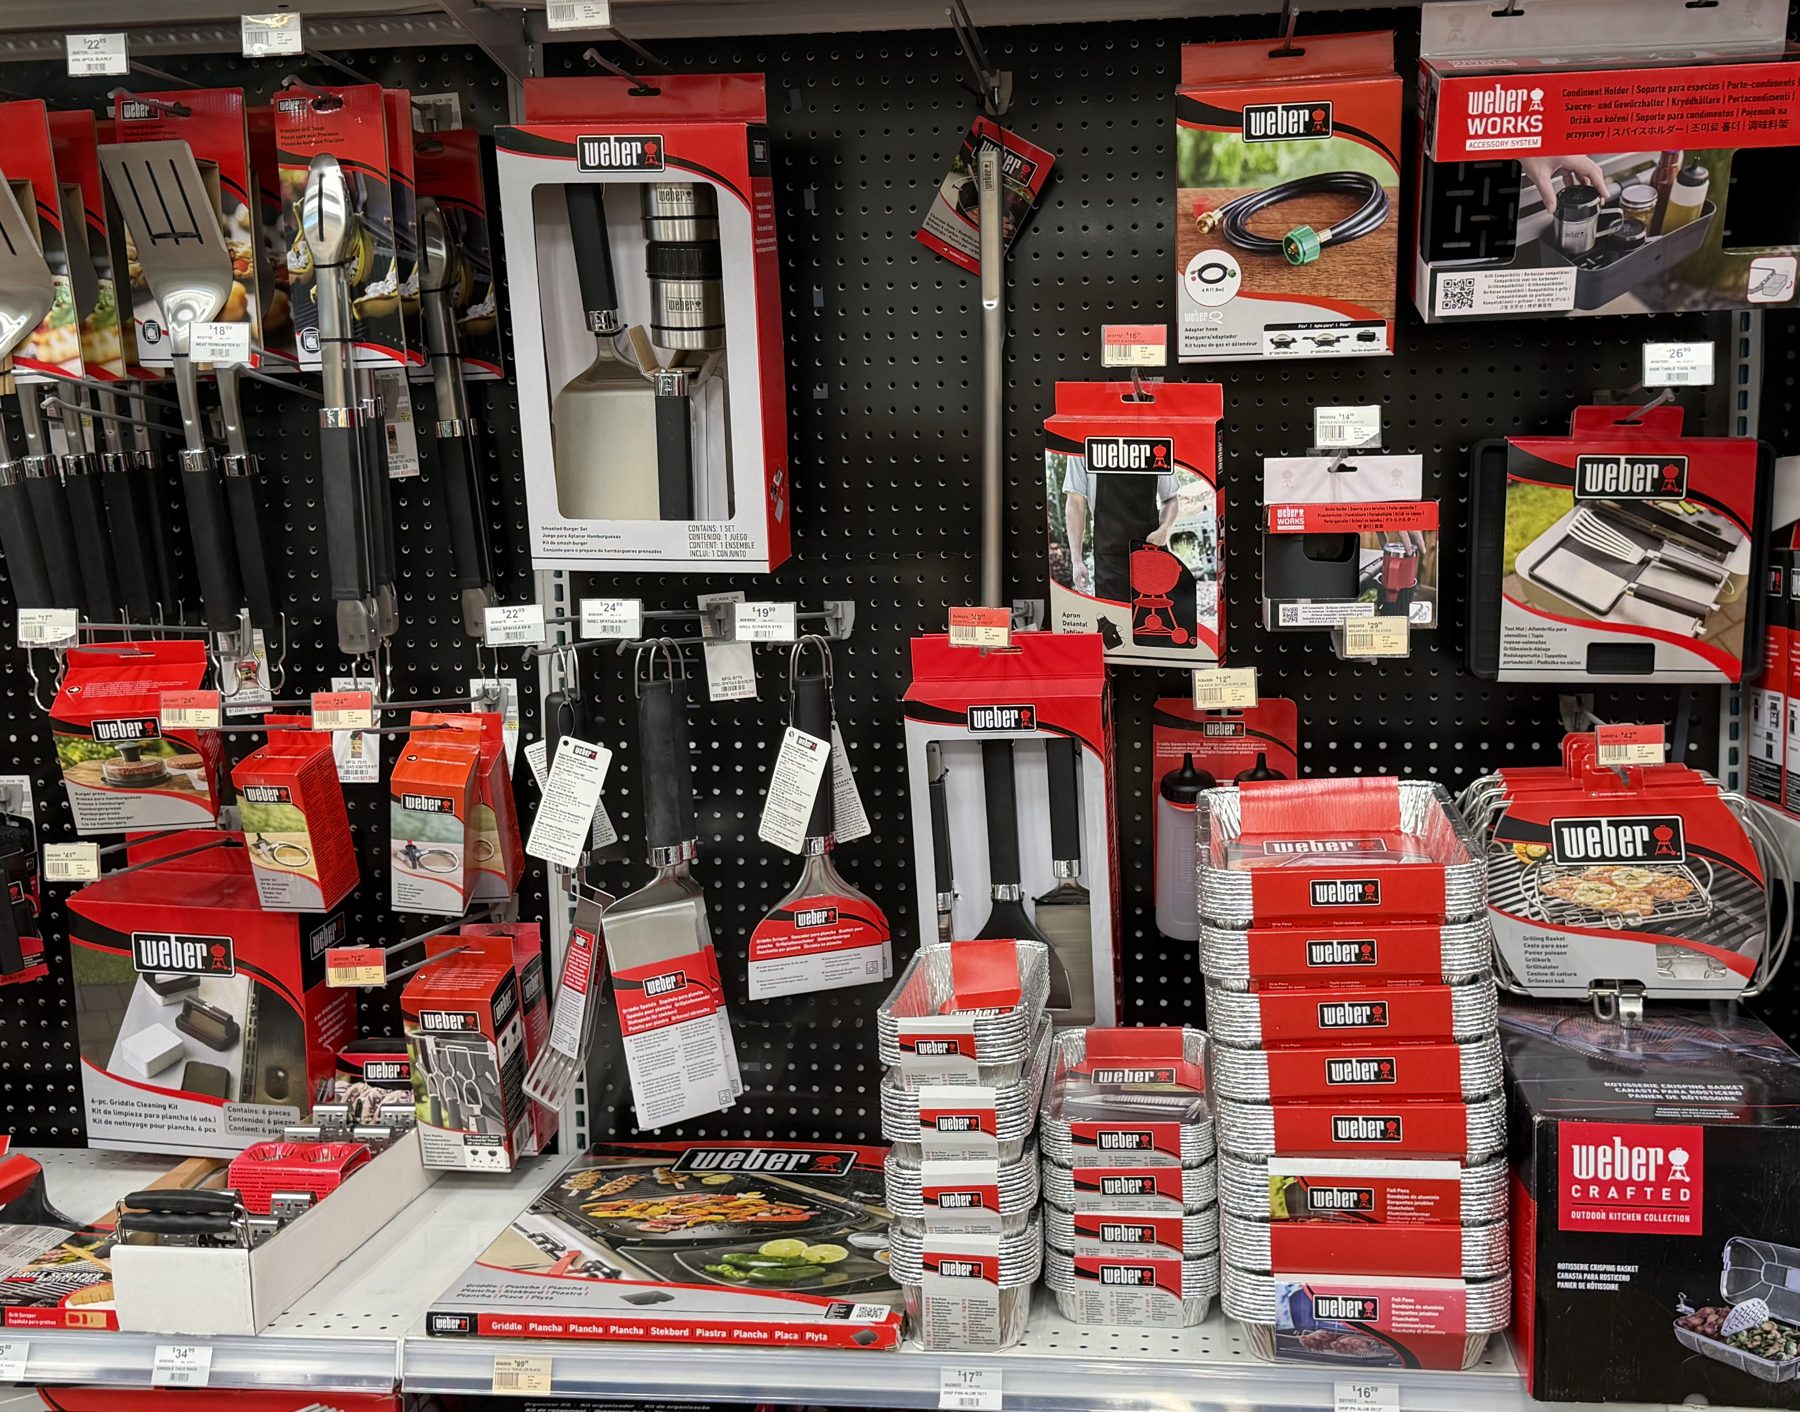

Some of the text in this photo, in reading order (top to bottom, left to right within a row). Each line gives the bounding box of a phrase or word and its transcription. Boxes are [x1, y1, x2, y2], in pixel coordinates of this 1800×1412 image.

[1636, 82, 1720, 95] Soporte para especias
[1726, 79, 1795, 90] Porte-condiments
[1468, 84, 1528, 115] weber
[1562, 87, 1630, 98] Condiment Holder
[1727, 93, 1790, 104] Portacondimenti
[1564, 99, 1664, 112] Saucen- und Gewürzhalter
[1671, 95, 1720, 108] Kryddhållare
[1570, 115, 1591, 125] Držák
[1604, 113, 1629, 123] koření
[1635, 109, 1734, 122] Soporte para condimentos
[1741, 107, 1787, 118] Pojemnik na
[1250, 104, 1309, 136] weber
[1467, 115, 1543, 136] WORKS
[1566, 130, 1605, 140] przyprawy
[1469, 138, 1539, 149] ACCESSORY SYSTEM
[583, 136, 641, 167] weber
[658, 187, 684, 202] weber
[668, 298, 695, 312] weber
[1184, 310, 1208, 323] weber
[1092, 438, 1147, 468] weber
[1585, 457, 1659, 493] weber
[1277, 507, 1299, 518] weber
[688, 524, 718, 533] CONTAINS:
[723, 525, 735, 533] SET
[688, 533, 722, 541] CONTENIDO:
[729, 533, 748, 541] JUEGO
[689, 541, 719, 549] CONTIENT:
[725, 541, 755, 550] ENSEMBLE
[689, 550, 710, 558] INCLUI:
[716, 550, 747, 558] CONJUNTO
[1062, 612, 1080, 620] Apron
[1062, 620, 1088, 628] Delantal
[972, 706, 1019, 728] weber
[97, 719, 142, 740] weber
[1206, 721, 1235, 736] weber
[247, 787, 279, 801] weber
[405, 796, 442, 812] weber
[1561, 819, 1650, 858] weber
[1273, 840, 1354, 854] weber
[1315, 880, 1363, 903] weber
[798, 909, 828, 926] weber
[312, 921, 337, 954] weber
[140, 934, 207, 969] weber
[1311, 941, 1360, 964] weber
[647, 975, 677, 995] weber
[424, 1011, 465, 1029] weber
[1323, 1002, 1371, 1025] weber
[918, 1040, 948, 1055] weber
[367, 1063, 399, 1078] weber
[1099, 1069, 1155, 1083] weber
[1331, 1058, 1378, 1081] weber
[1603, 1081, 1659, 1089] ROTISSERIE
[91, 1098, 109, 1106] 6-pc.
[109, 1099, 135, 1107] Griddle
[136, 1100, 167, 1111] Cleaning
[113, 1110, 142, 1119] limpieza
[144, 1112, 160, 1120] para
[161, 1113, 190, 1123] plancha
[190, 1115, 198, 1123] (6
[199, 1115, 217, 1124] uds.)
[228, 1106, 261, 1115] Contains:
[268, 1109, 291, 1118] pieces
[114, 1119, 148, 1129] nettoyage
[149, 1122, 166, 1130] pour
[167, 1122, 196, 1132] plancha,
[228, 1115, 265, 1125] Contenido:
[939, 1116, 970, 1131] weber
[229, 1125, 260, 1133] Contient:
[1337, 1116, 1385, 1139] weber
[1101, 1131, 1140, 1149] weber
[689, 1148, 811, 1171] weber
[1571, 1136, 1664, 1182] weber
[1104, 1177, 1142, 1194] weber
[1571, 1184, 1691, 1201] CRAFTED
[941, 1192, 972, 1207] weber
[1313, 1188, 1357, 1208] weber
[1571, 1210, 1690, 1223] OUTDOOR KITCHEN COLLECTION
[1104, 1224, 1142, 1242] weber
[942, 1261, 973, 1276] weber
[1557, 1262, 1639, 1273] ROTISSERIE CRISPING BASKET
[1103, 1266, 1142, 1285] weber
[1557, 1272, 1630, 1282] CANASTA PARA ROSTICERO
[1557, 1281, 1620, 1291] PANIER DE RÔTISSOIRE
[1318, 1296, 1362, 1318] weber
[436, 1317, 460, 1330] weber
[491, 1321, 522, 1331] Griddle
[529, 1322, 563, 1332] Plancha
[569, 1324, 604, 1334] Plancha
[610, 1325, 644, 1335] Plancha
[651, 1327, 689, 1337] Stekbord
[696, 1328, 727, 1338] Piastra
[733, 1329, 768, 1339] Plancha
[775, 1330, 799, 1340] Placa
